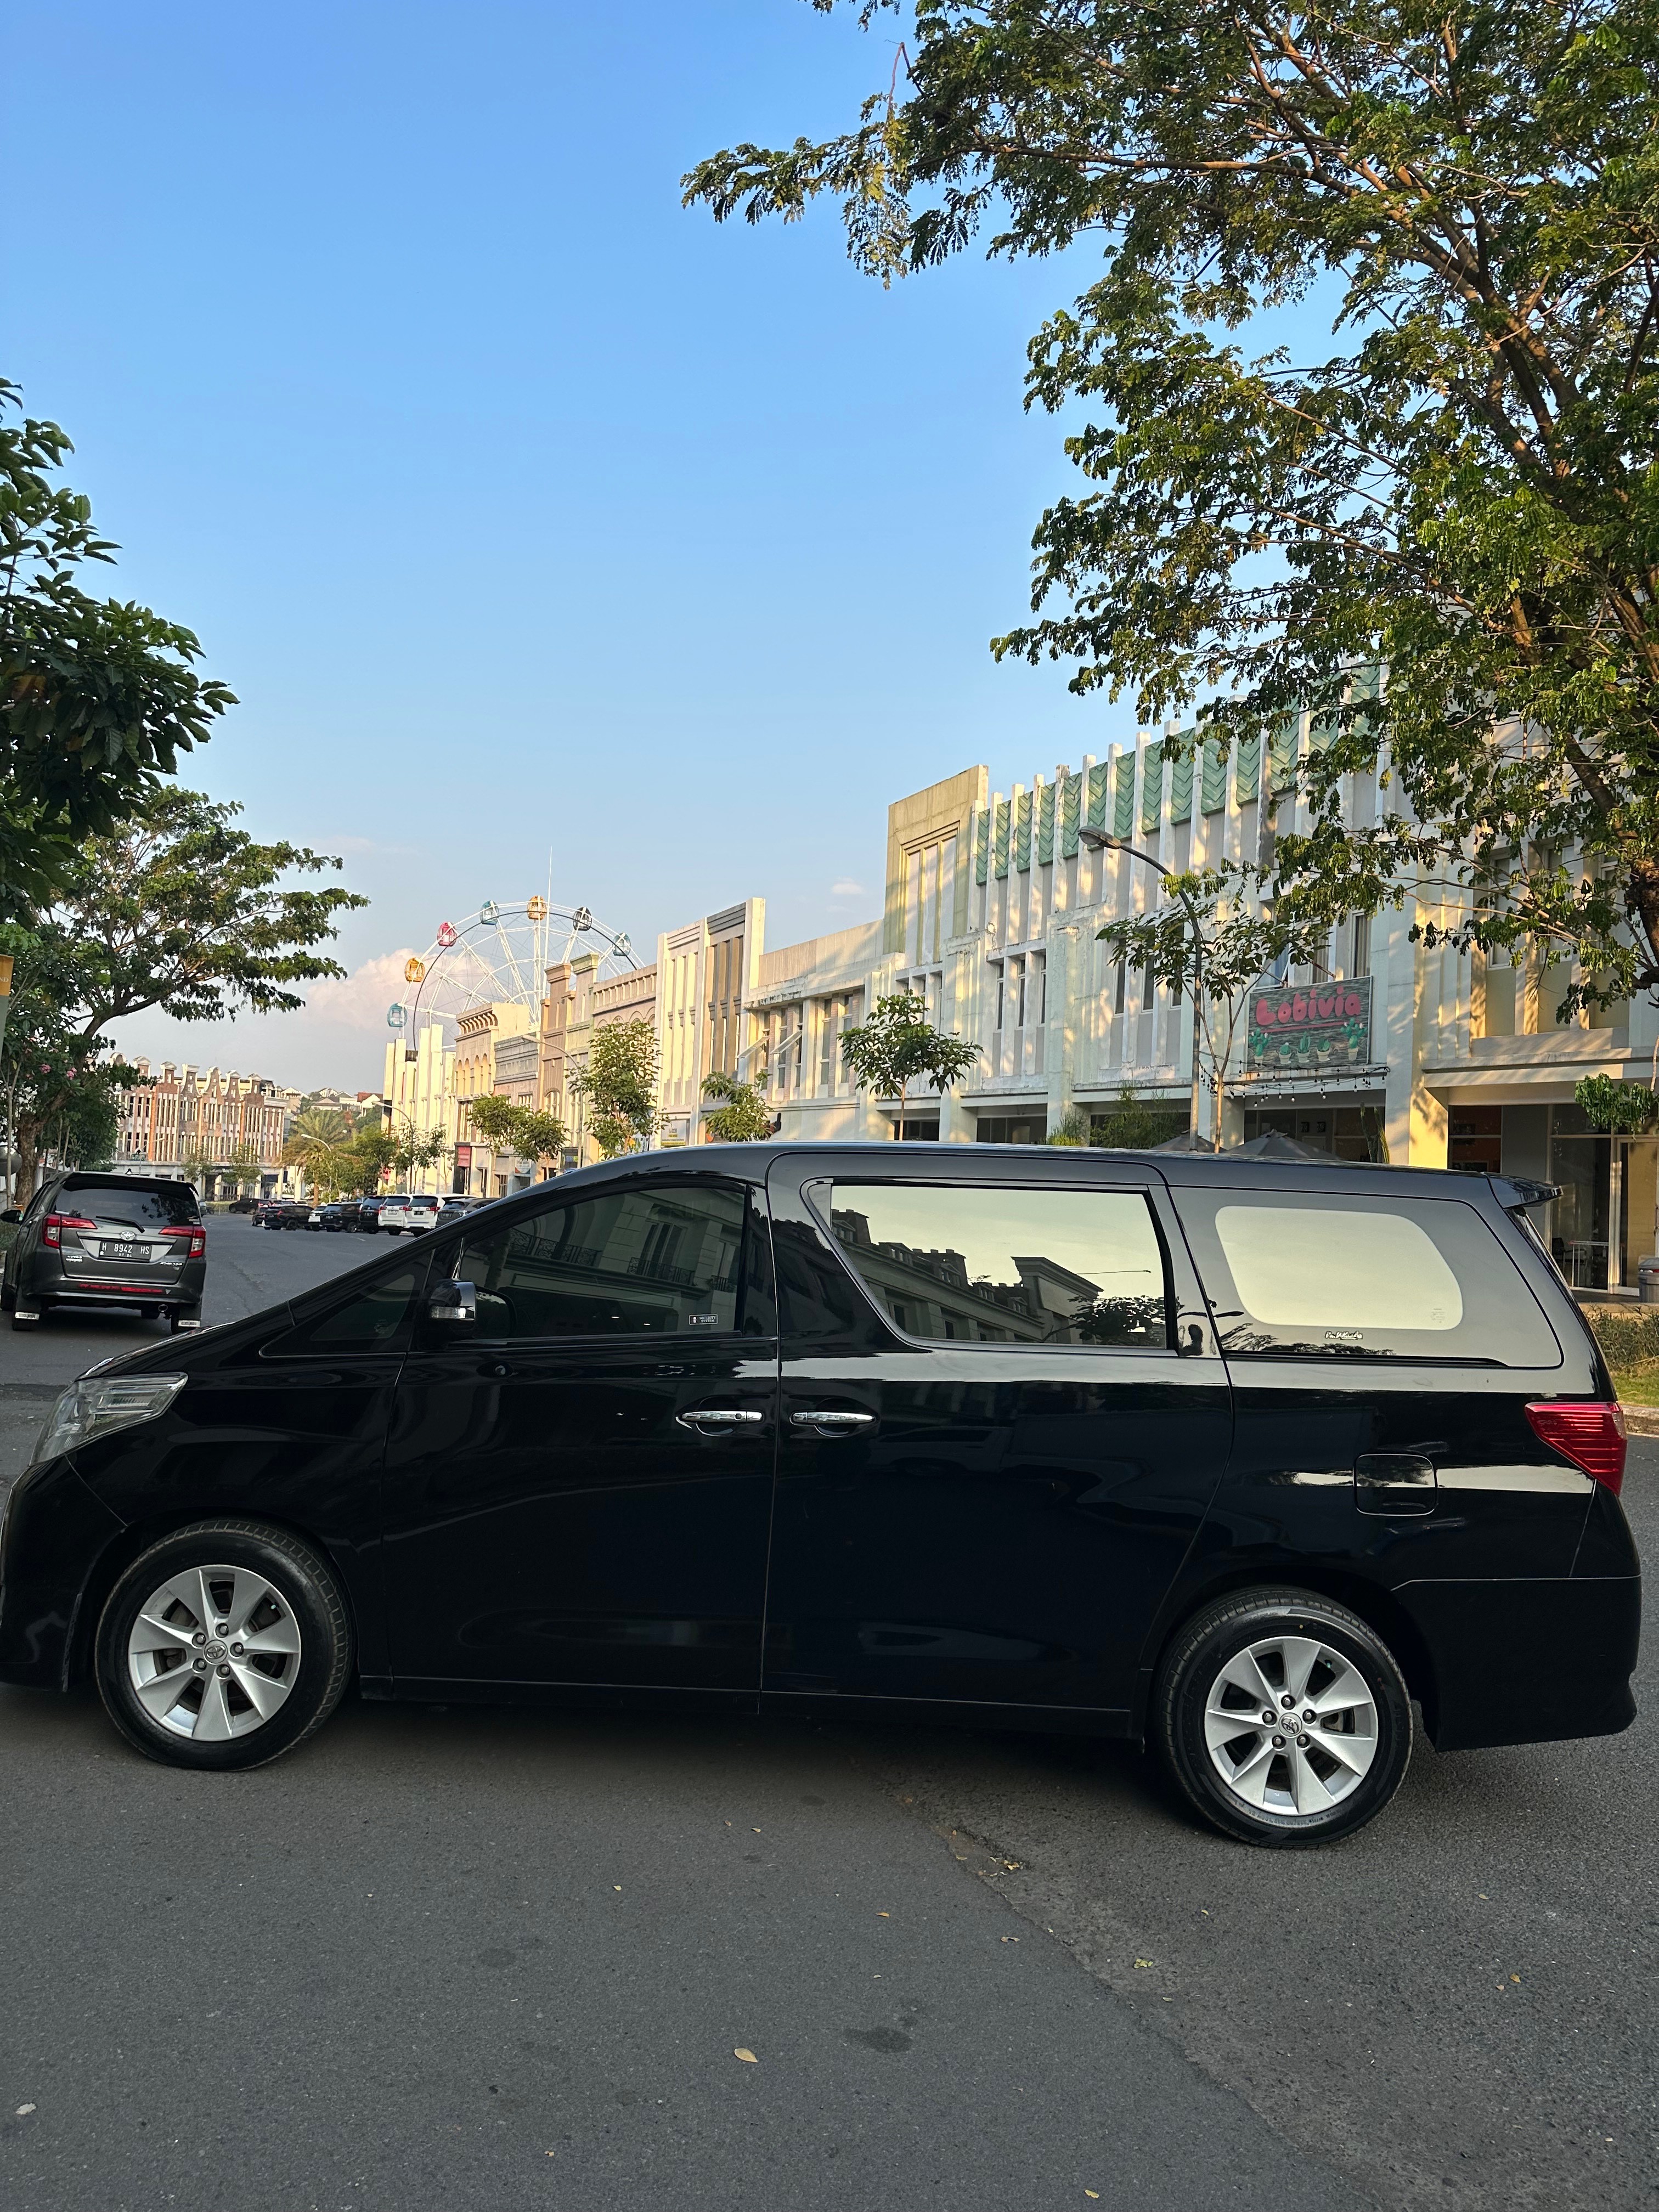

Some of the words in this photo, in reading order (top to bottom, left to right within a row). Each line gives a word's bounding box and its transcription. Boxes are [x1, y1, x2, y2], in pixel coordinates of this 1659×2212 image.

[1256, 985, 1361, 1025] Lobivia
[102, 1243, 107, 1251] H
[114, 1244, 133, 1254] 8942
[140, 1246, 150, 1255] HS
